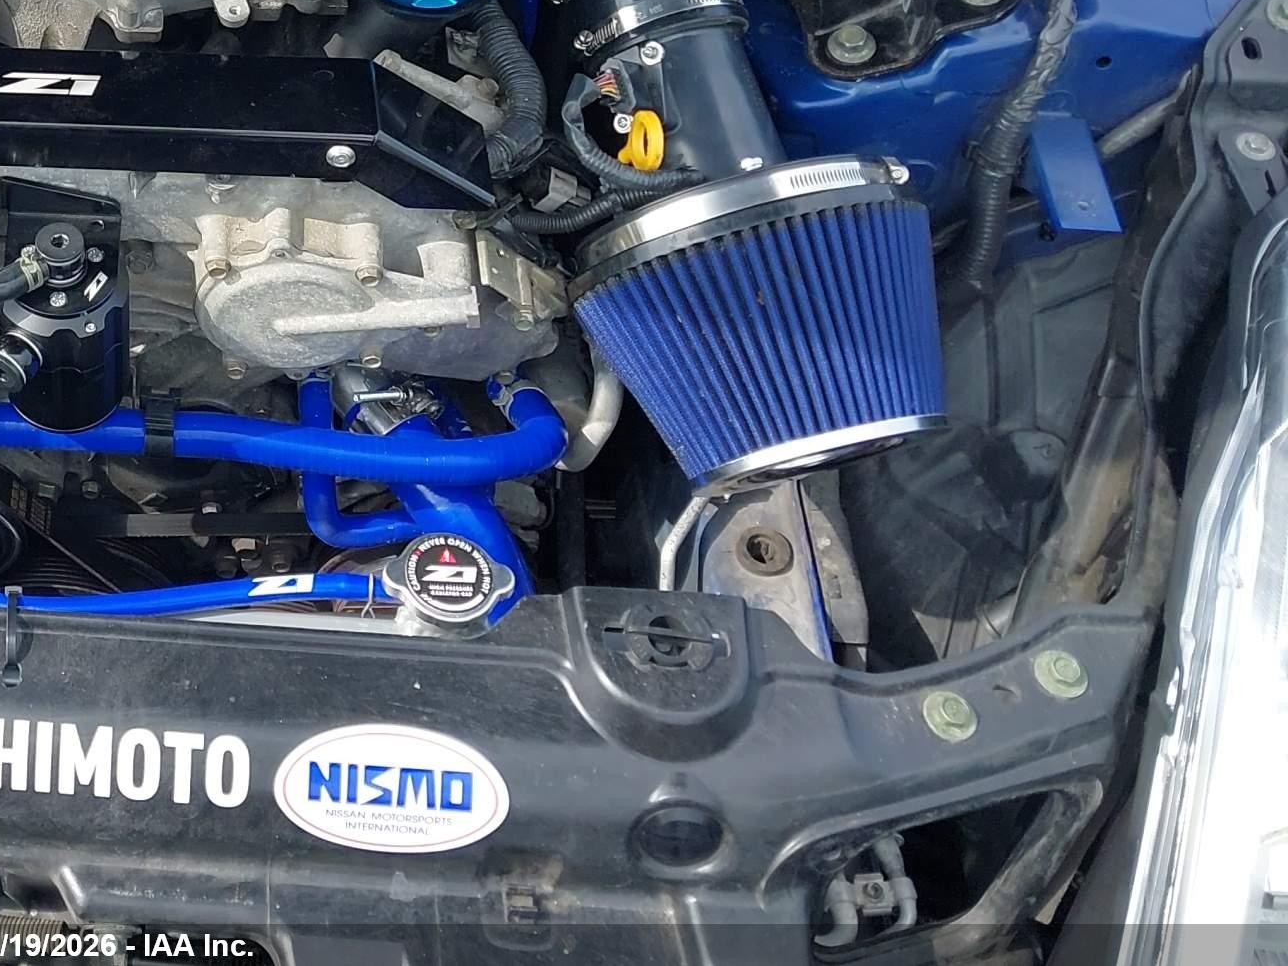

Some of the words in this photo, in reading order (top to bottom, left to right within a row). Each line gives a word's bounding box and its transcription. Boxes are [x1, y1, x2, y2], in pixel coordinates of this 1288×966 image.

[418, 537, 446, 553] NEVER
[446, 537, 473, 553] OPEN
[471, 549, 491, 577] WHEN
[407, 553, 421, 592] CAUTION
[480, 576, 491, 594] HOT
[308, 761, 474, 812] NISMO
[325, 808, 366, 820] NISSAN
[371, 812, 454, 826] MOTORSPORTS
[345, 821, 431, 836] INTERNATIONAL
